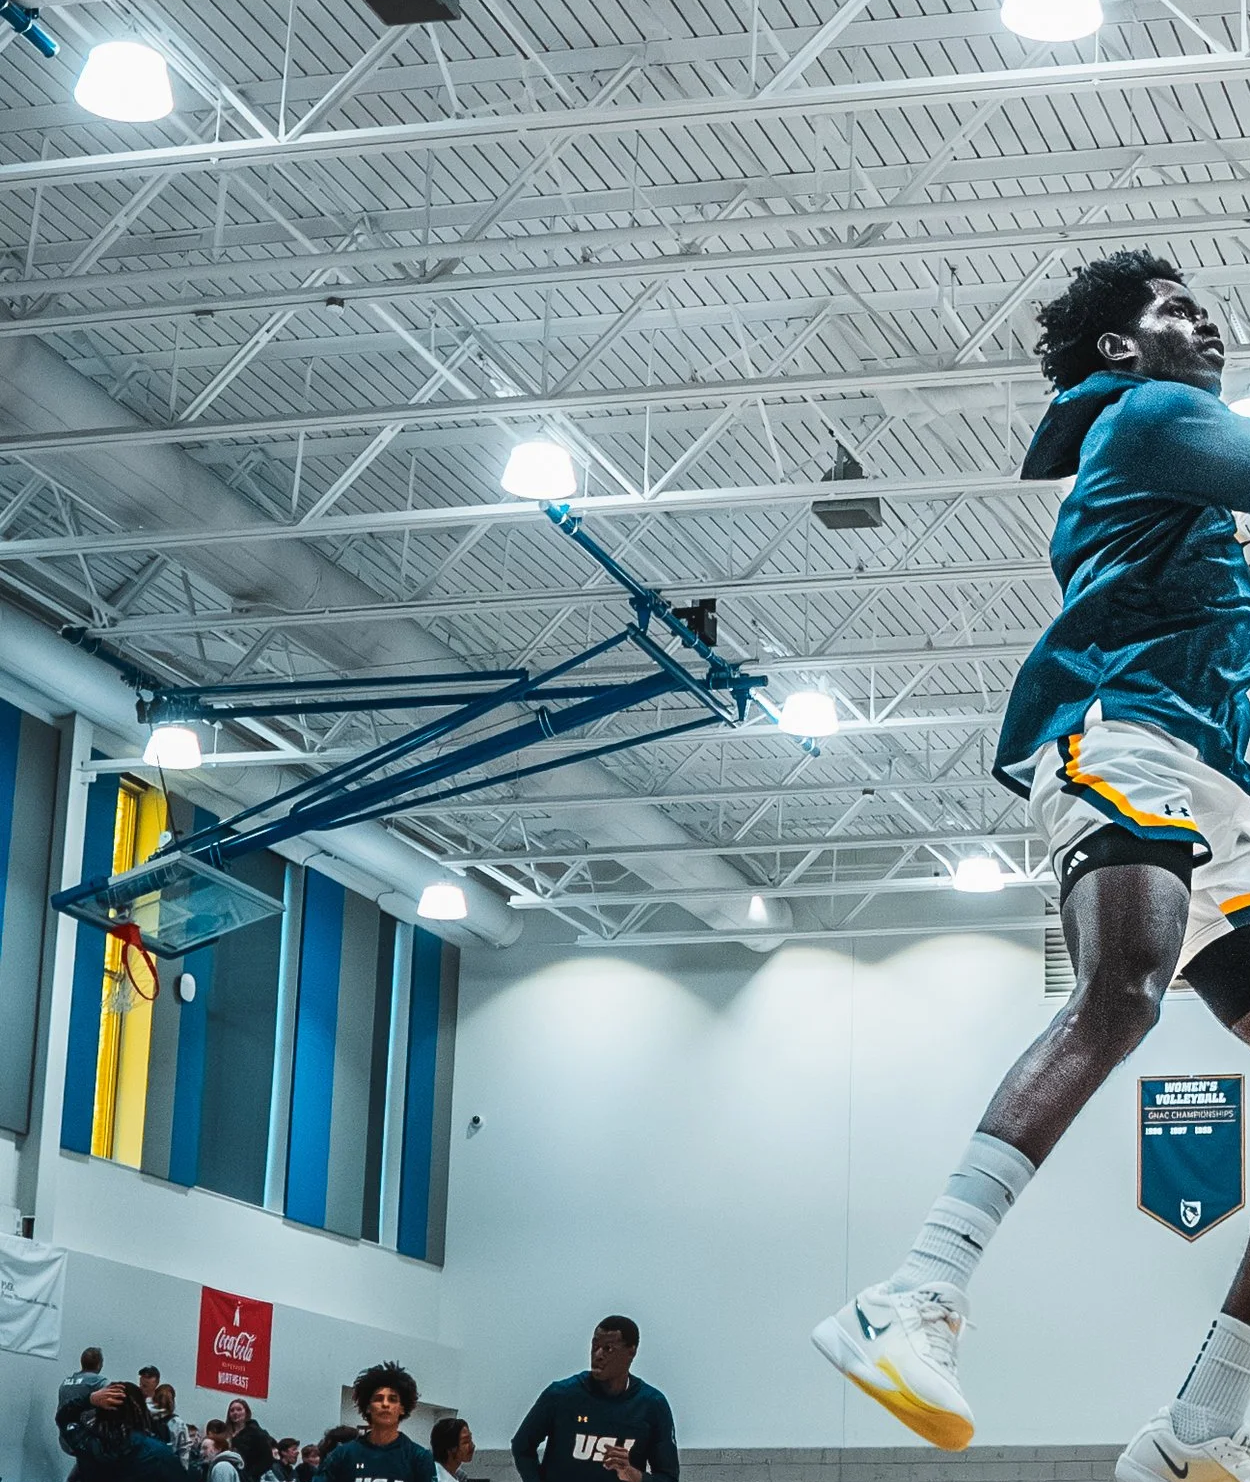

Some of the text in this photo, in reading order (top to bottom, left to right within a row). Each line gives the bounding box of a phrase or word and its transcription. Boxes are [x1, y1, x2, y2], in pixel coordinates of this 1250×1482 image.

[1164, 1081, 1218, 1093] WOMEN'S
[1155, 1093, 1226, 1105] VOLLEYBALL
[1171, 1110, 1234, 1119] CHAMPIONSHIPS
